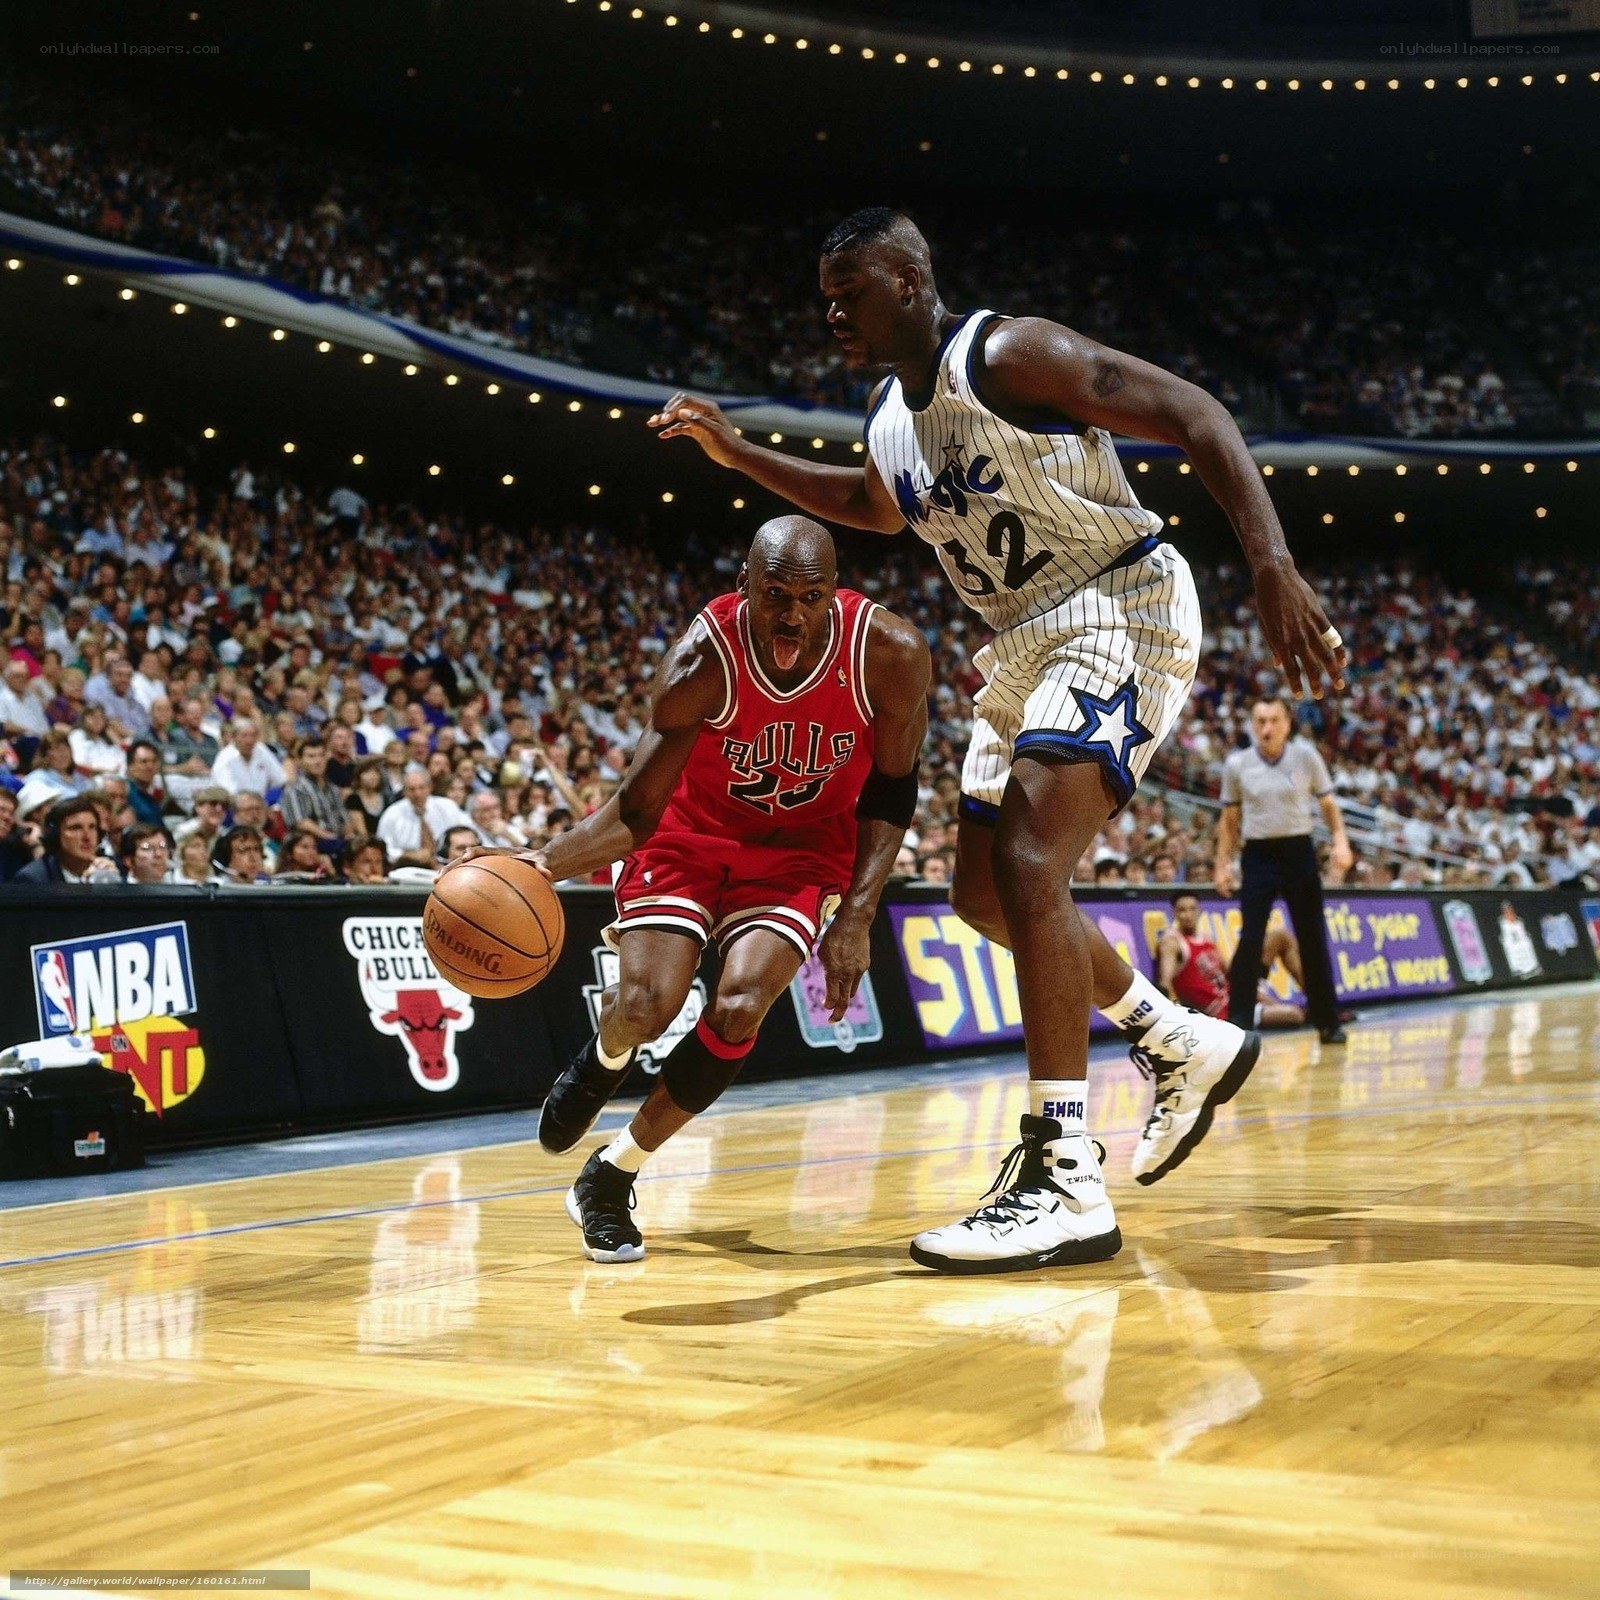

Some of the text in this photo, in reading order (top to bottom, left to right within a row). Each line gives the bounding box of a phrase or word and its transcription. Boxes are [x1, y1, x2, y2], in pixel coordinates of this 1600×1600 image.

[940, 510, 1056, 596] 32
[721, 721, 856, 780] BULLS
[373, 956, 437, 980] BULL
[425, 908, 502, 975] SPALDING
[73, 935, 188, 1032] NBA
[1042, 1100, 1084, 1119] SHAQ
